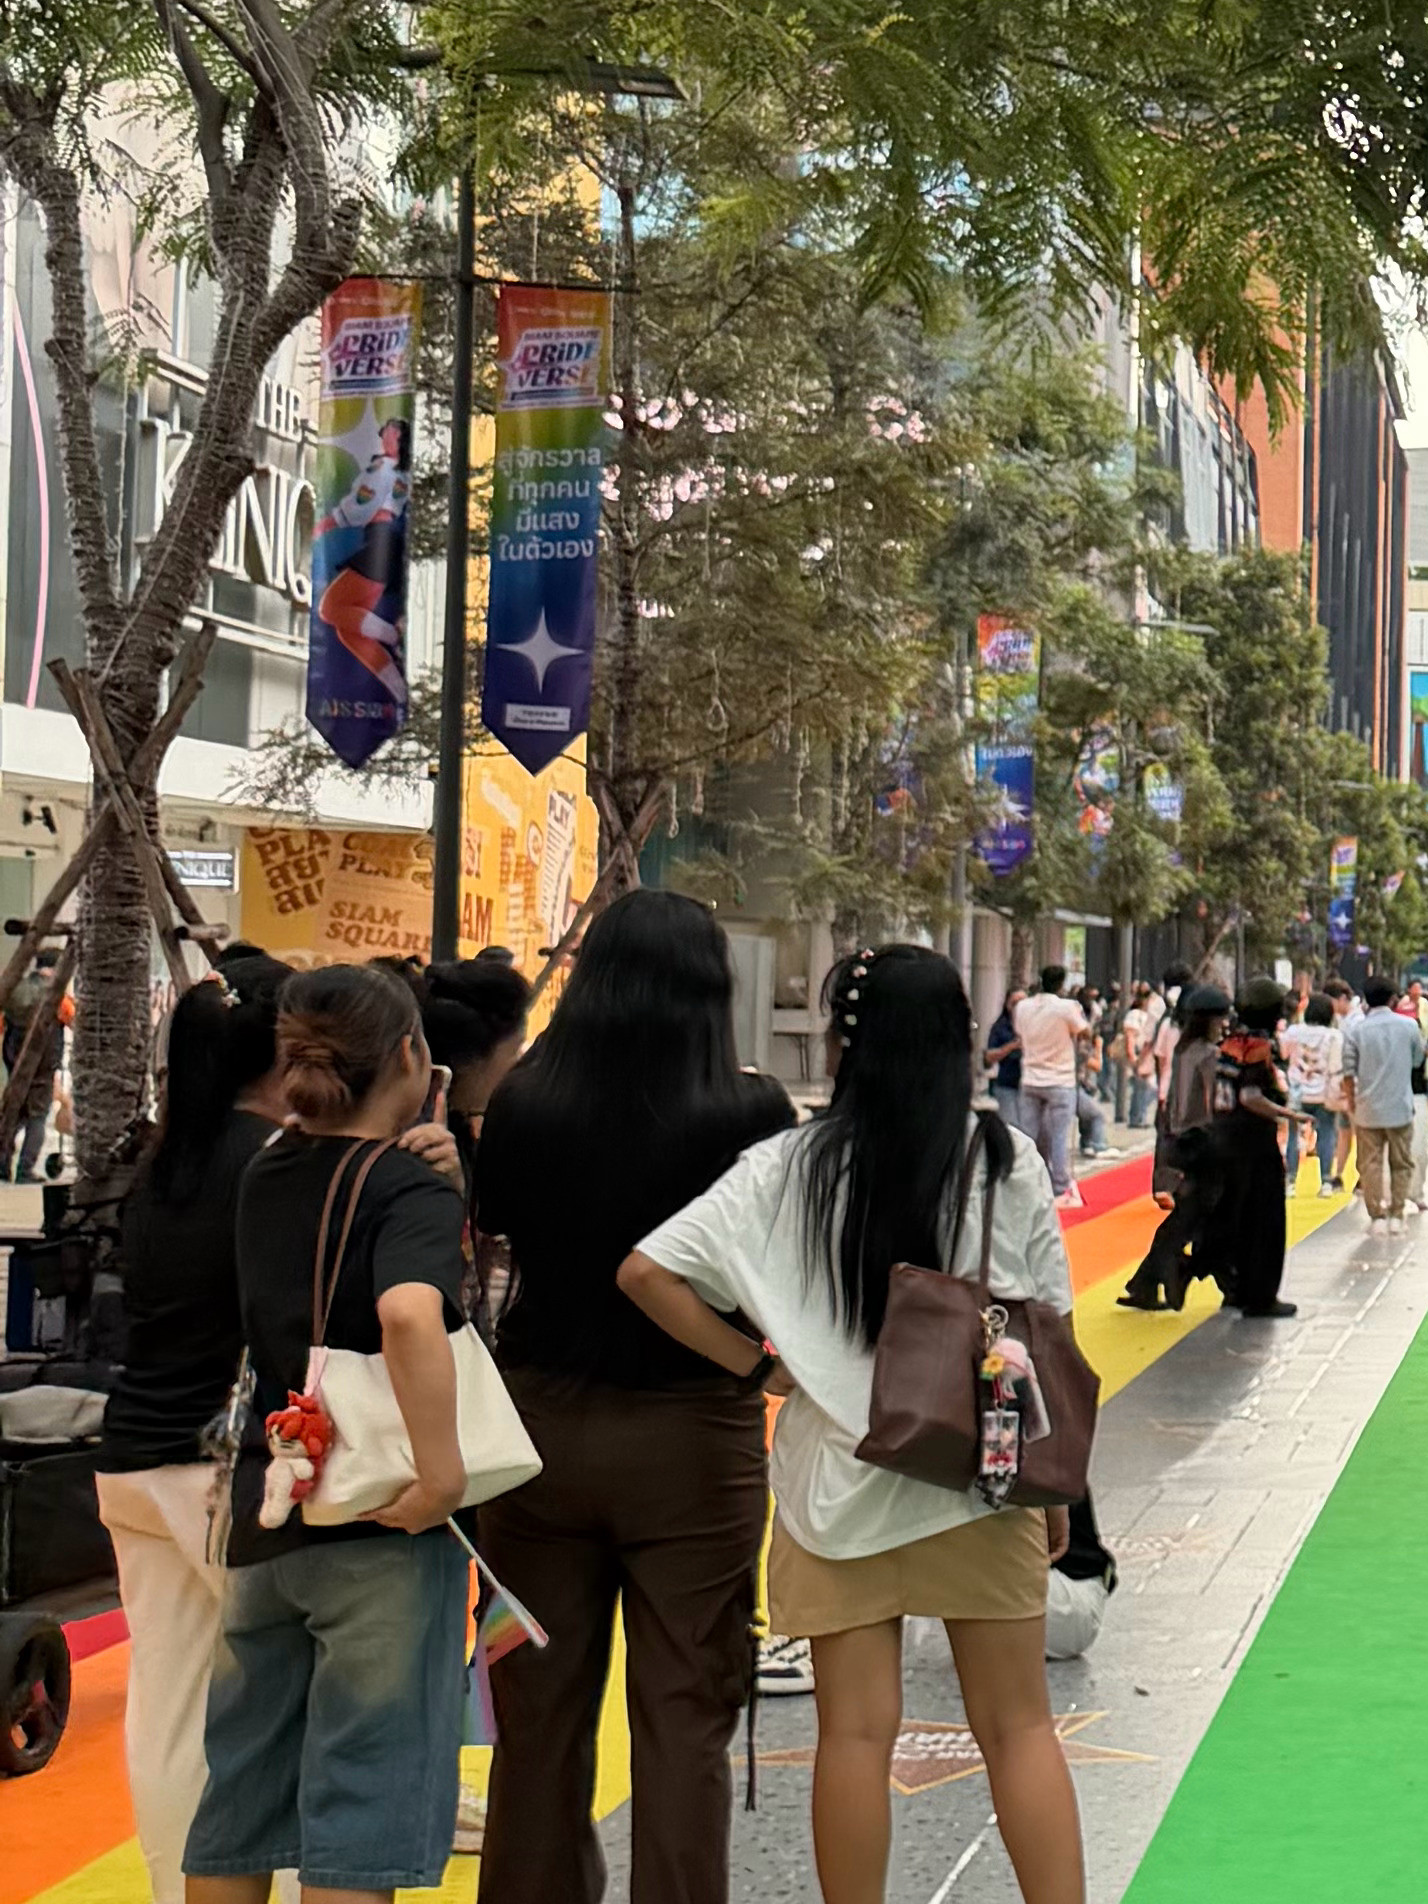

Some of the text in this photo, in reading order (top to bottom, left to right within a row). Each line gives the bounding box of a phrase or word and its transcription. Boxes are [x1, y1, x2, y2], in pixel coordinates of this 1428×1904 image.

[516, 507, 581, 532] มีแสง
[498, 534, 595, 562] ในตัวเอง
[329, 899, 403, 927] SIAM
